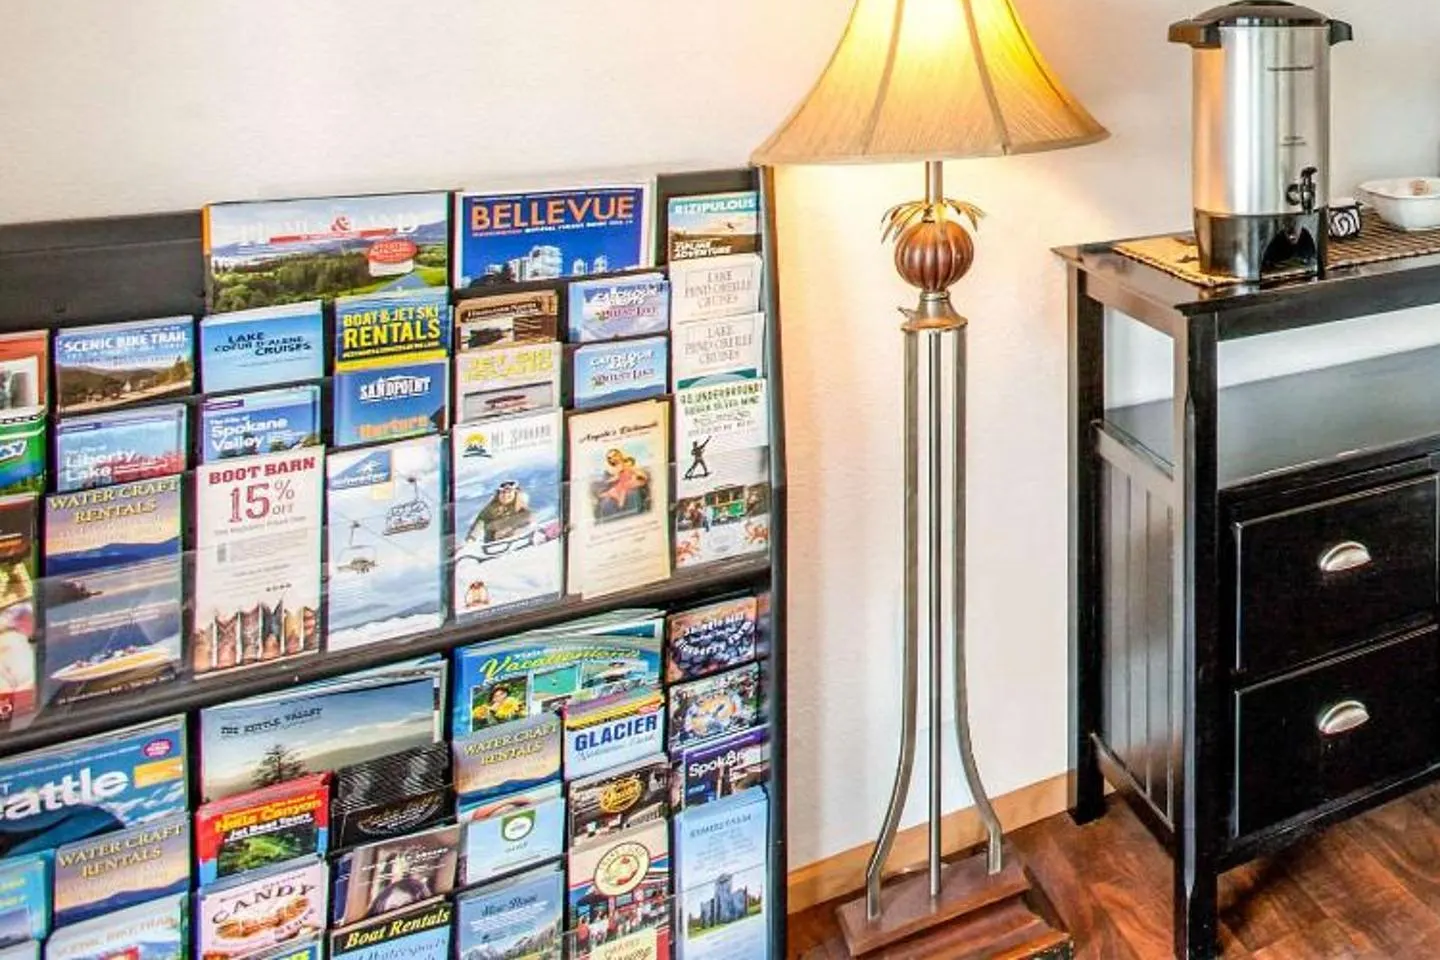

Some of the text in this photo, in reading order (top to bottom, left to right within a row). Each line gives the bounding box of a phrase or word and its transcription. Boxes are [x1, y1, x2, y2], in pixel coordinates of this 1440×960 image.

[471, 196, 634, 231] BELLEVUE
[343, 310, 378, 327] BOAT
[392, 306, 415, 321] JET
[417, 303, 439, 320] SKI
[63, 329, 188, 353] SCENIC BIKE TRAIL
[228, 332, 265, 344] LAKE
[343, 319, 441, 350] RENTALS
[254, 342, 312, 357] CRUISES
[212, 418, 288, 439] Spokane
[211, 435, 265, 453] Valley
[66, 448, 136, 468] Liberty
[208, 456, 316, 485] BOOT BARN
[66, 466, 112, 482] Lake
[51, 478, 178, 510] WATER CRAFT
[228, 479, 295, 524] 15 %
[75, 498, 157, 524] RENTALS
[464, 734, 512, 757] WATER
[575, 714, 658, 752] GLACIER
[481, 740, 543, 766] RENTALS
[0, 767, 129, 821] attle
[262, 799, 322, 819] Canyon
[60, 824, 184, 868] WATER CRAFT
[82, 847, 163, 878] RENTALS
[212, 883, 315, 924] CANDY
[344, 926, 387, 950] Boat
[390, 909, 450, 938] Rentals
